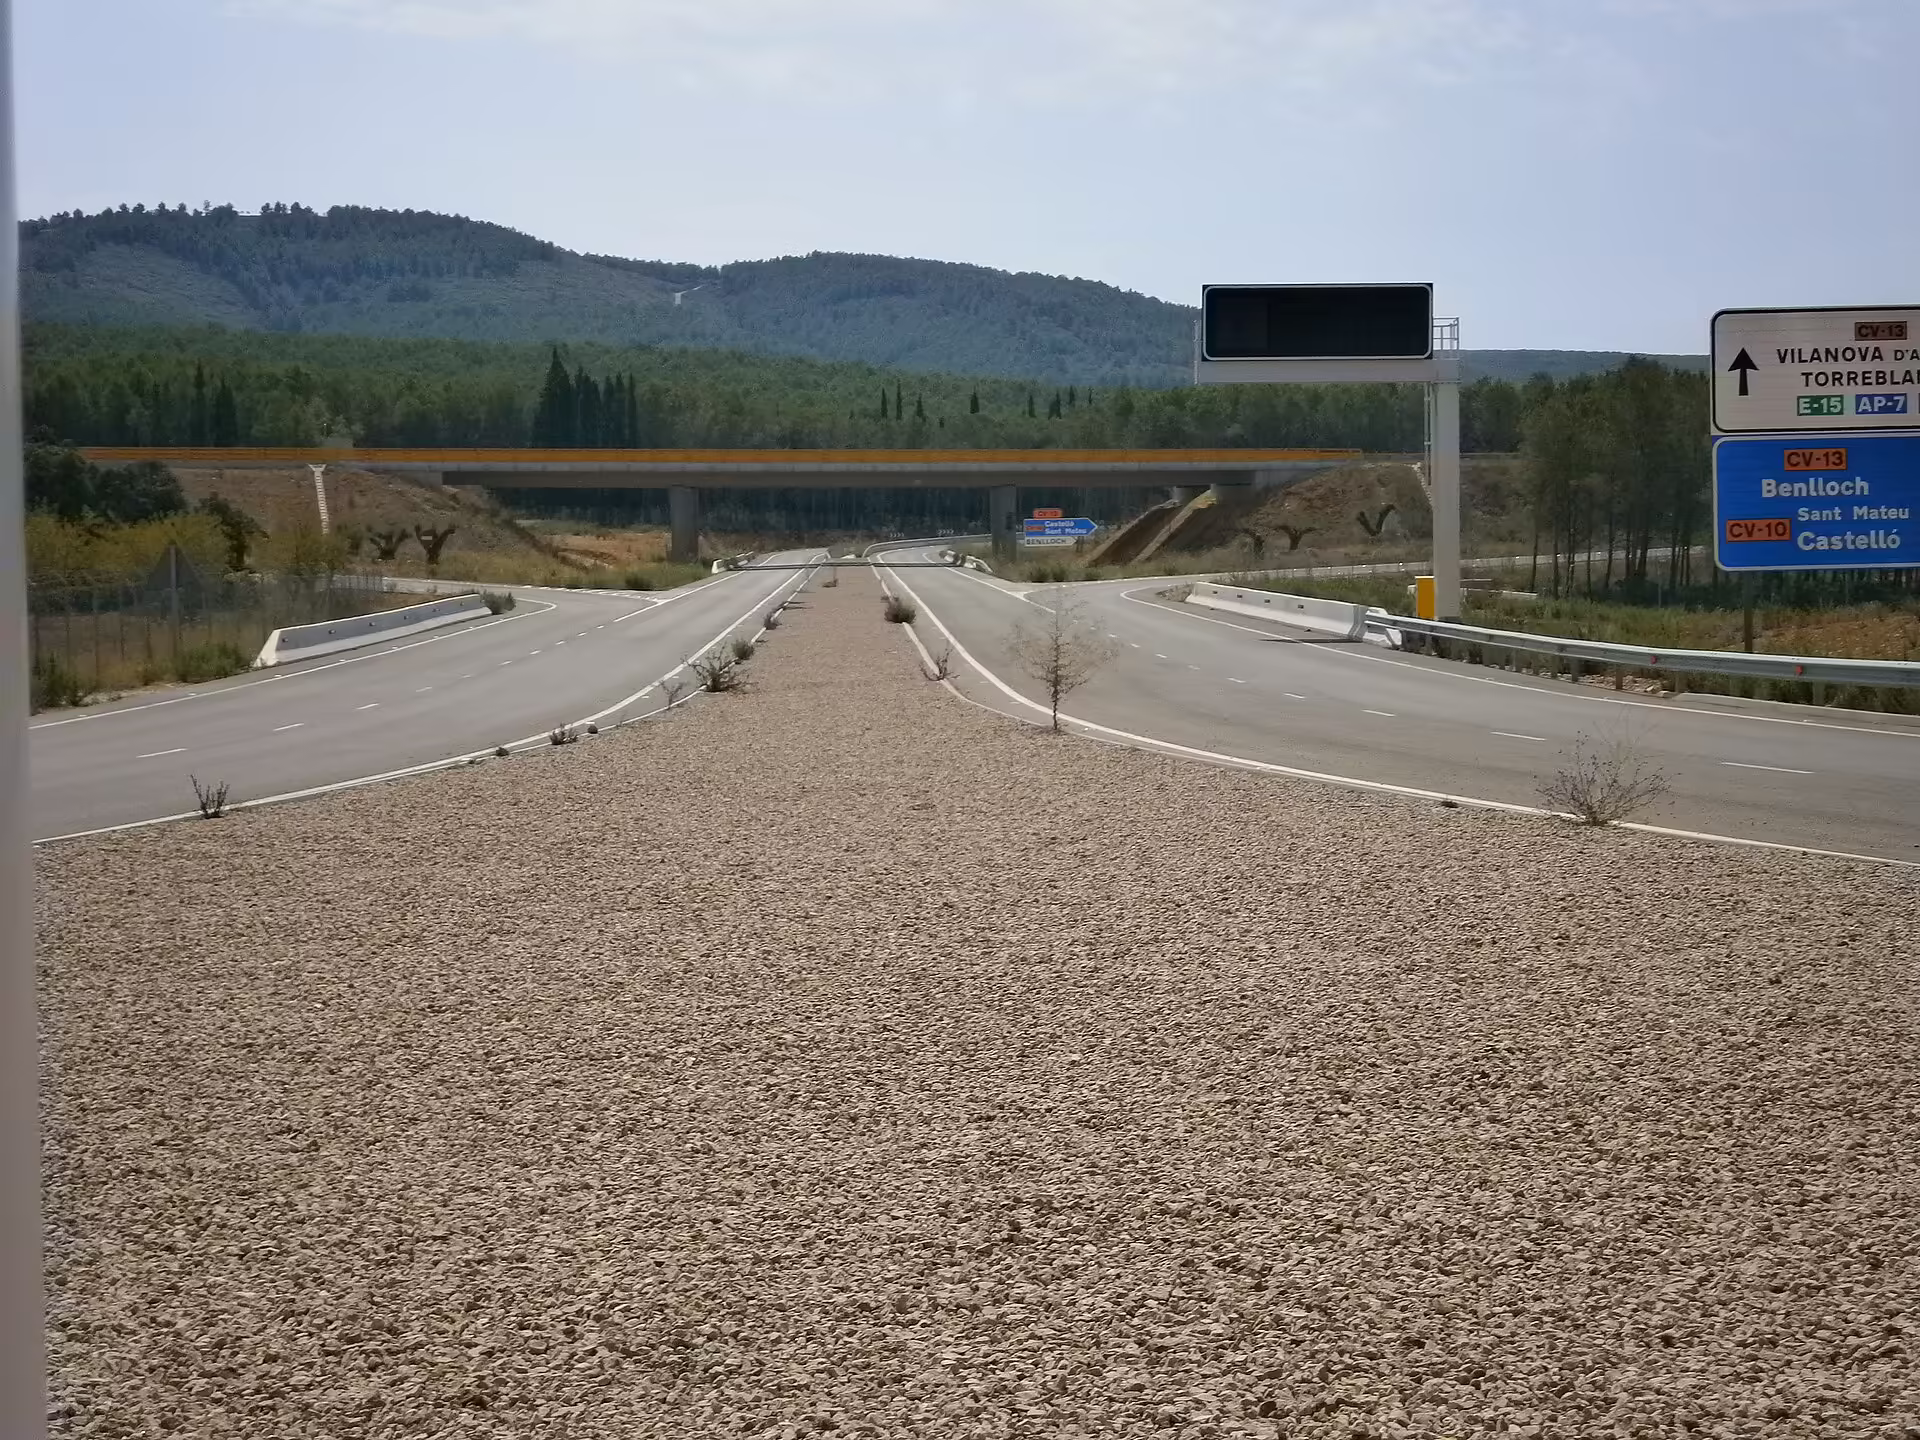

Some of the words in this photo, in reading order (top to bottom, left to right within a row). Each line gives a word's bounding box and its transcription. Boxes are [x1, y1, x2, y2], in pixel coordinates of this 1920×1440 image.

[1857, 323, 1905, 338] CV-13
[1776, 347, 1884, 364] VILANOVA
[1799, 397, 1842, 414] E-15
[1857, 396, 1906, 413] AP-7
[1787, 451, 1844, 467] CV-13
[1761, 477, 1869, 498] Benlloch
[1797, 507, 1842, 521] Sant
[1853, 505, 1909, 520] Mateu
[1729, 521, 1787, 538] CV-10
[1797, 529, 1901, 550] Castelló
